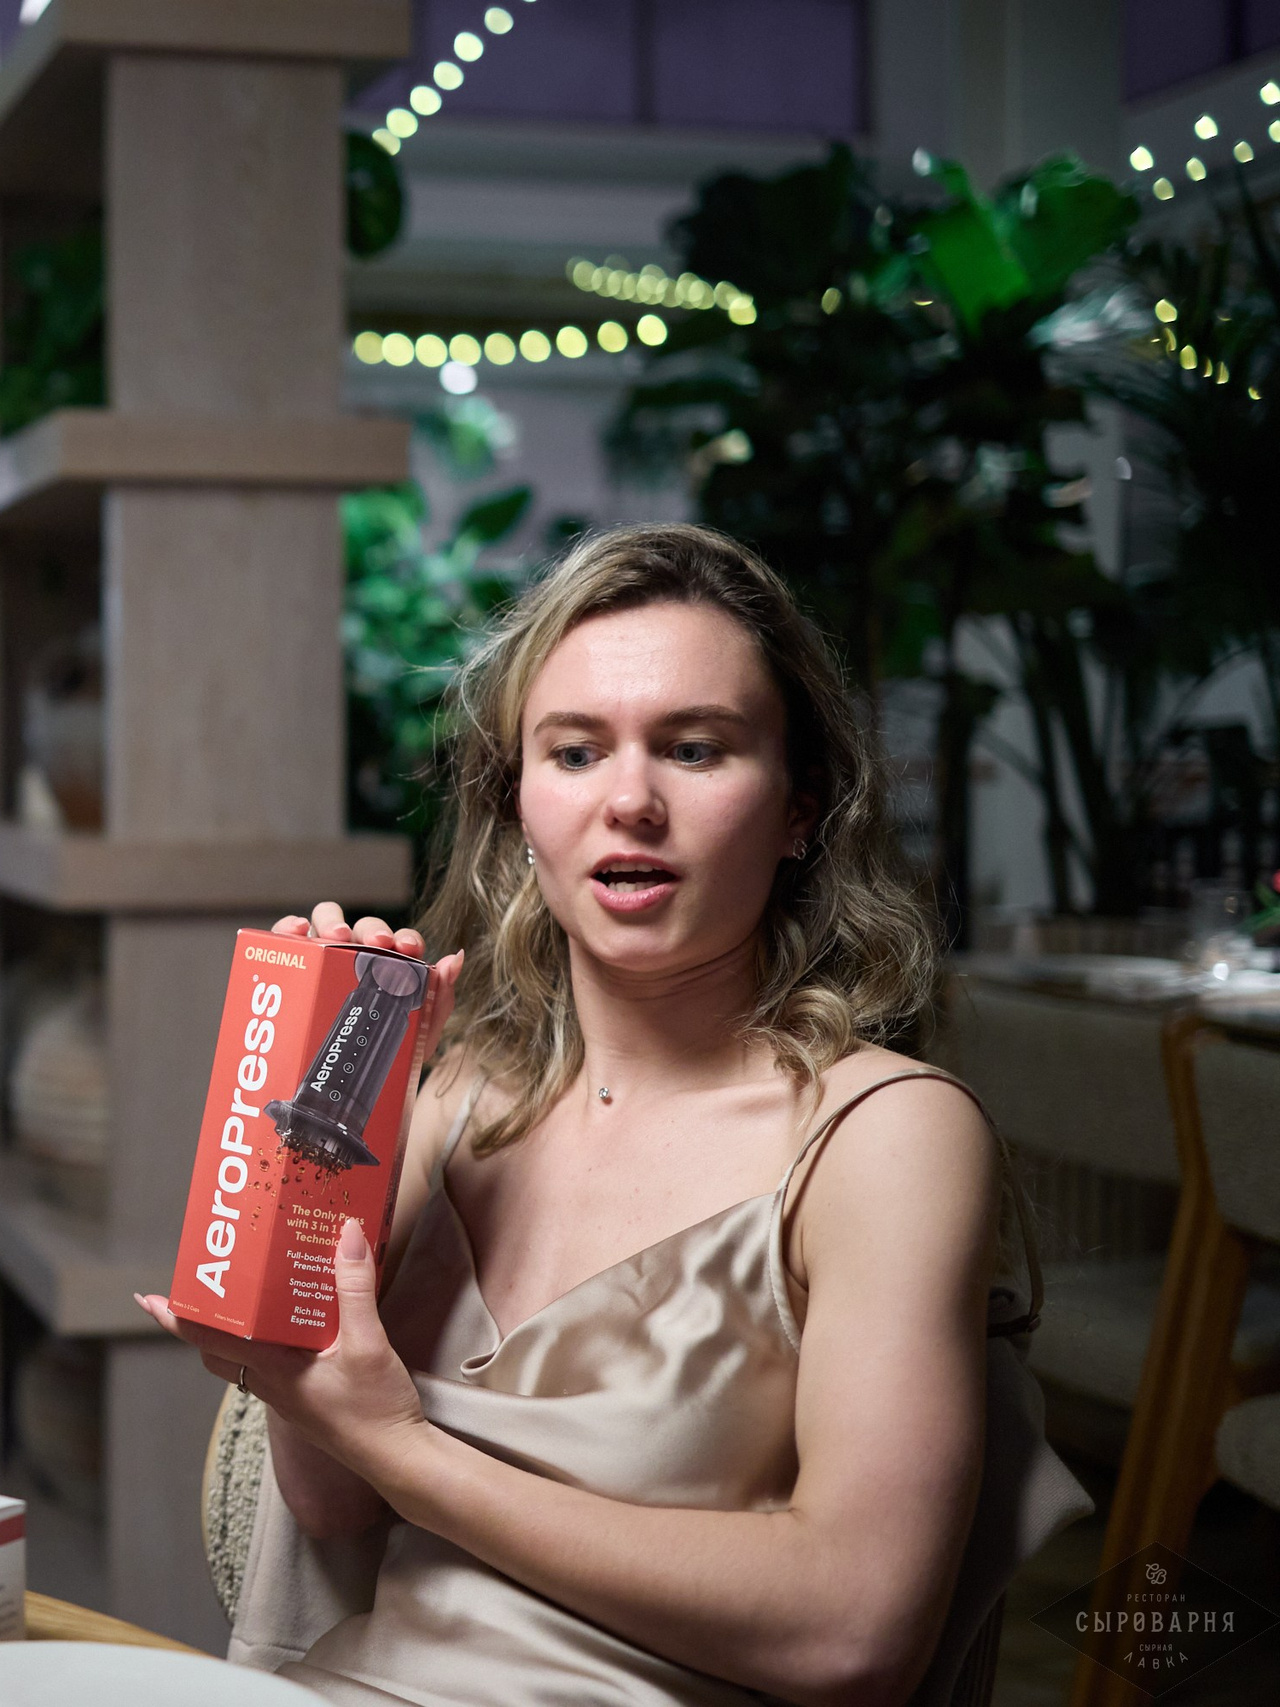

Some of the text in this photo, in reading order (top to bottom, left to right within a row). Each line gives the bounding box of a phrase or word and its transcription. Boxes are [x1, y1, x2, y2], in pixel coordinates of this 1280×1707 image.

[245, 946, 307, 970] ORIGINAL
[310, 1006, 363, 1093] AeroPress
[195, 981, 282, 1299] AeroPress
[292, 1204, 365, 1225] The Only Prs
[286, 1218, 308, 1229] with
[311, 1221, 318, 1230] 3
[320, 1222, 329, 1232] in
[331, 1225, 337, 1234] 1
[295, 1231, 341, 1247] Technolo
[286, 1250, 332, 1265] Full-bodied
[293, 1261, 336, 1275] French Pre
[289, 1277, 319, 1289] Smooth
[320, 1282, 334, 1292] like
[292, 1288, 334, 1302] Pour-Over
[190, 1304, 200, 1313] Cups
[294, 1306, 326, 1318] Rich like
[226, 1317, 245, 1326] Included
[290, 1315, 326, 1328] Espresso
